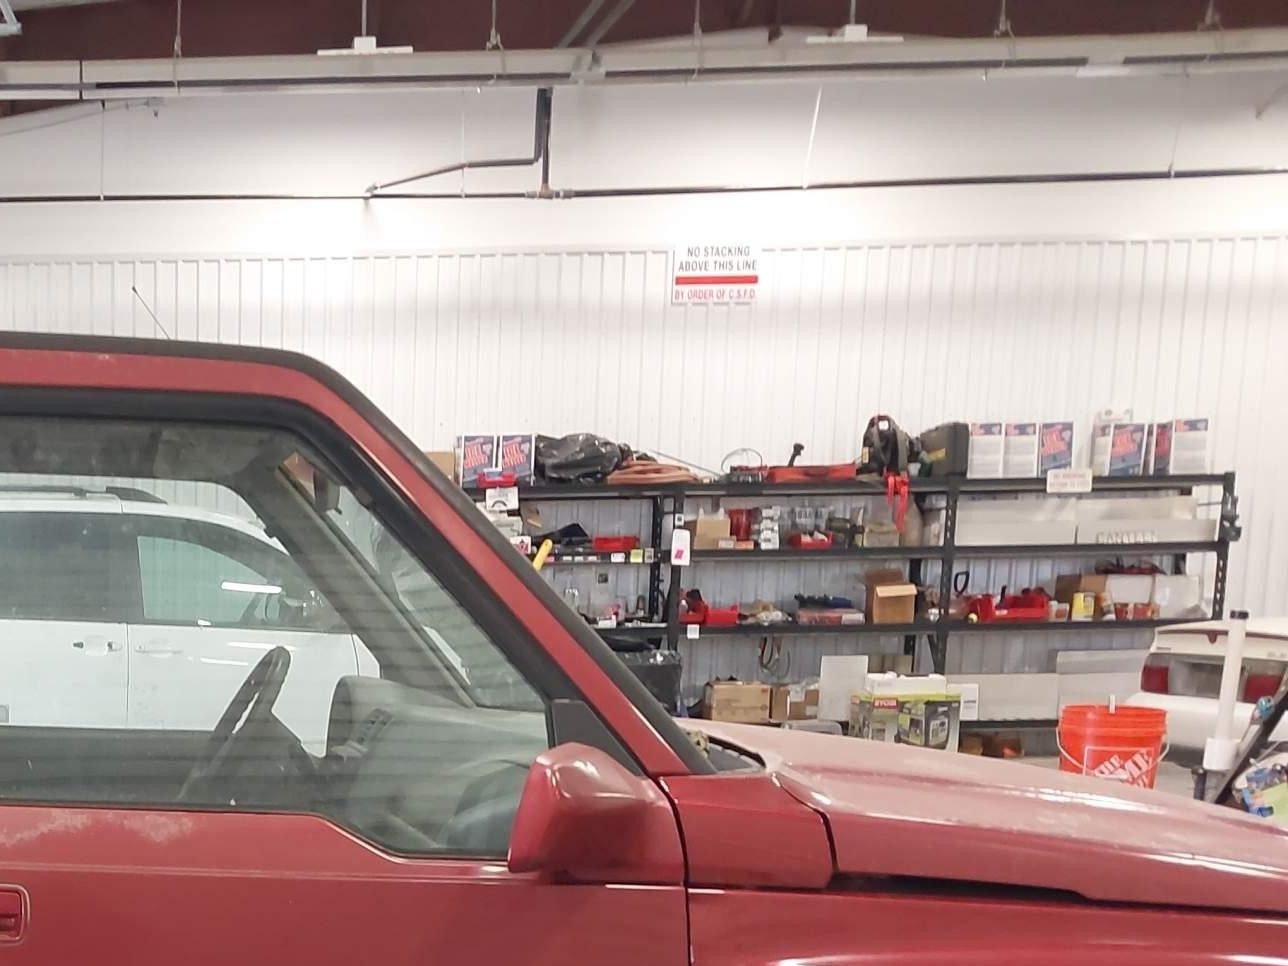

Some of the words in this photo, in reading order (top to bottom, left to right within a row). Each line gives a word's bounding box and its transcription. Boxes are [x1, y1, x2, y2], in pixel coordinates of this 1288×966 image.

[687, 246, 701, 257] NO
[704, 246, 751, 257] STACKING
[678, 261, 709, 272] ABOVE
[714, 260, 734, 271] THIS
[737, 259, 757, 271] LINE
[675, 289, 685, 300] BY
[687, 289, 713, 300] ORDER
[716, 289, 725, 300] OF
